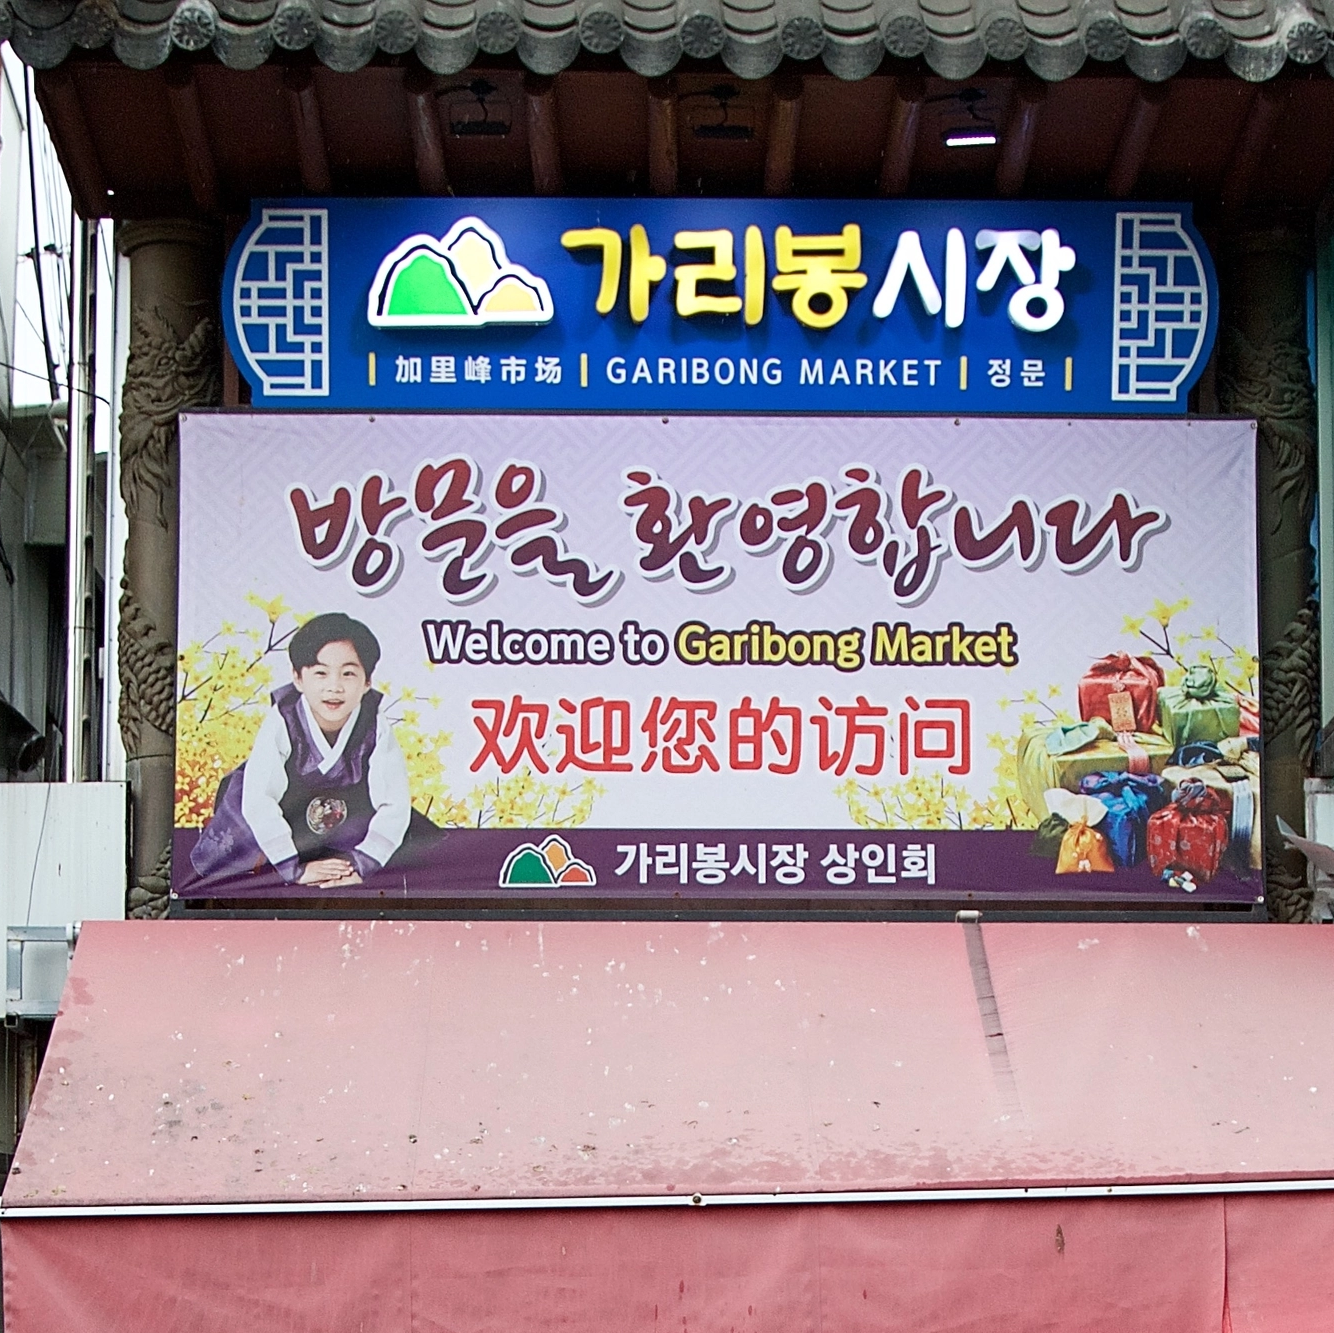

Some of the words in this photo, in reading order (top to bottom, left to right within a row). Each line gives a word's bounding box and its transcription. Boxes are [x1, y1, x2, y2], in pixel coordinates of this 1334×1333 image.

[560, 223, 1077, 333] 가리봉시장
[394, 354, 563, 386] 加里峰市场
[606, 357, 783, 386] GARIBONG
[799, 358, 942, 387] MARKET
[987, 358, 1046, 389] 정문
[287, 457, 616, 599] 방문을
[623, 467, 1163, 600] 환영합니다
[425, 622, 611, 663] Welcome
[623, 624, 666, 663] to
[676, 623, 864, 668] Garibong
[873, 625, 1015, 666] Market
[469, 694, 971, 777] 欢迎您的访问
[614, 842, 810, 885] 가리봉시장
[820, 842, 936, 885] 상인회
